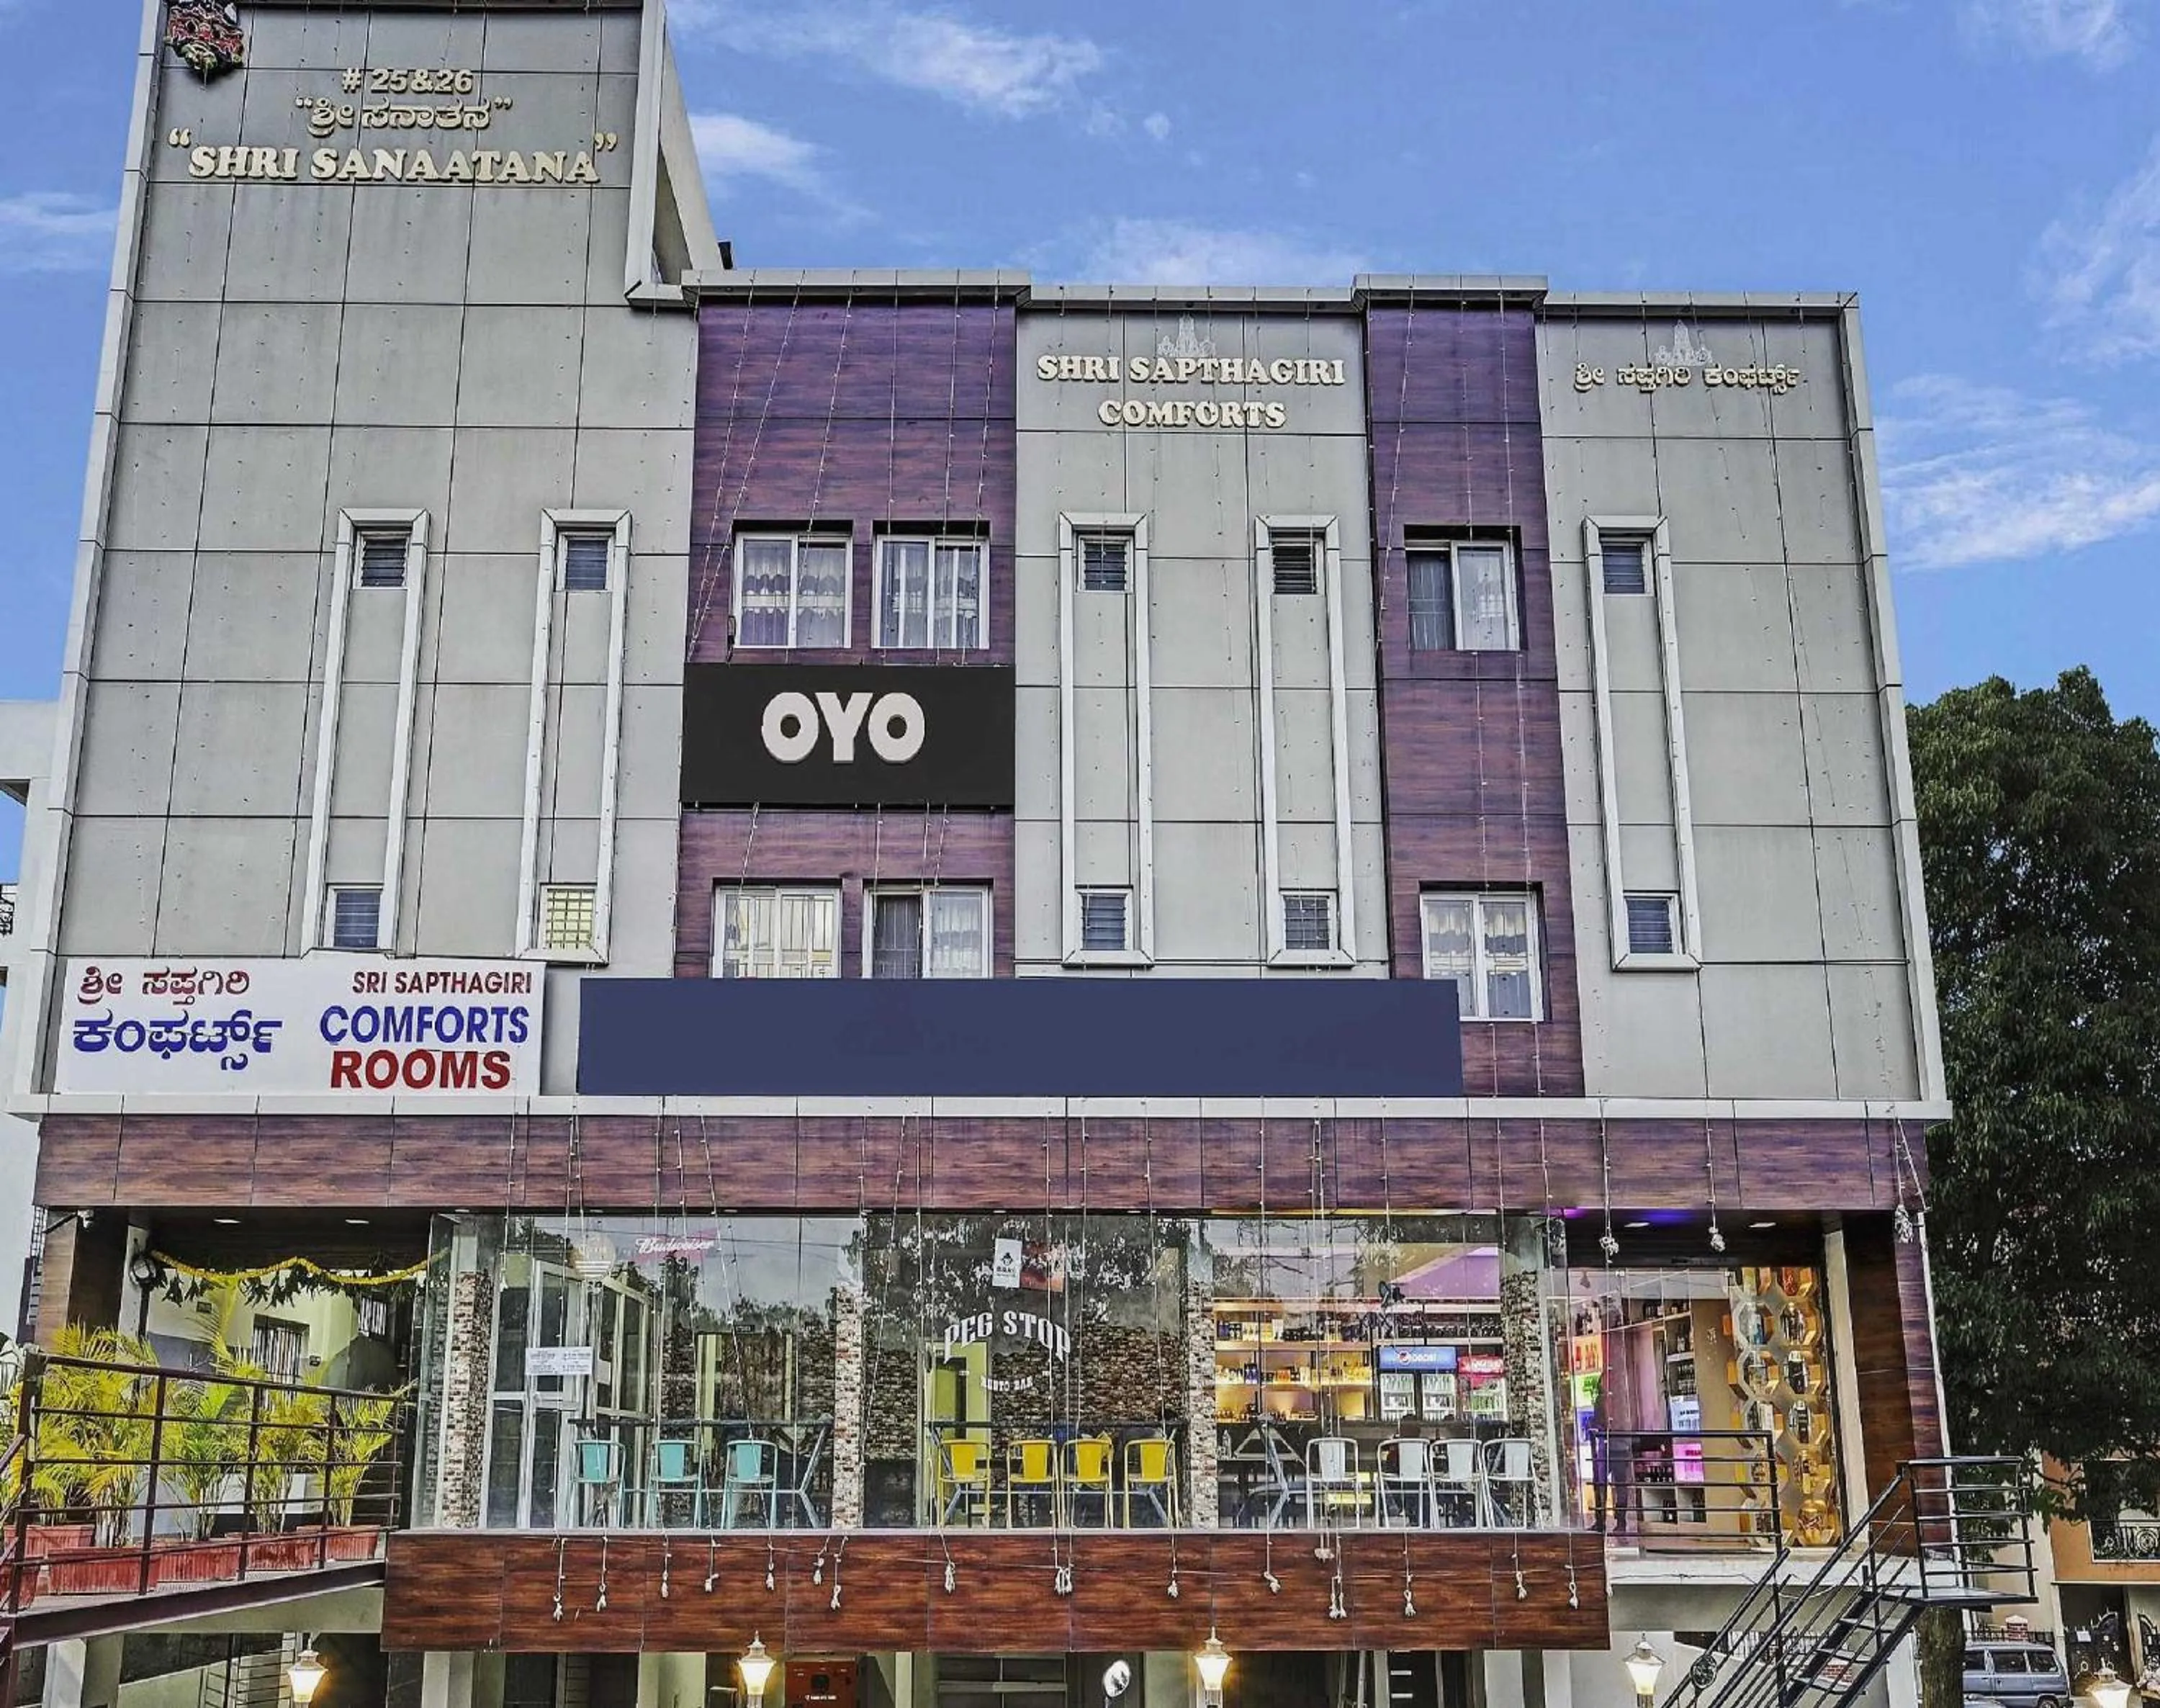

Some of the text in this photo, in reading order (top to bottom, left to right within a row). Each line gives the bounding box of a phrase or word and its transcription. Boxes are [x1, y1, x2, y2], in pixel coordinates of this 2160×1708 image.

[369, 70, 474, 94] 25&26
[1037, 354, 1346, 385] SHRI SAPTHAGIRI
[1097, 400, 1287, 428] COMFORTS
[761, 691, 925, 764] OYO
[76, 966, 251, 1006] ಶ್ರೀ ಸಪ್ತಗಿರಿ
[352, 971, 531, 994] SRI SAPTHAGIRI
[320, 1005, 528, 1044] COMFORTS
[330, 1051, 511, 1089] ROOMS
[635, 1237, 716, 1254] Budweiser
[944, 1310, 1071, 1364] PEG STOP
